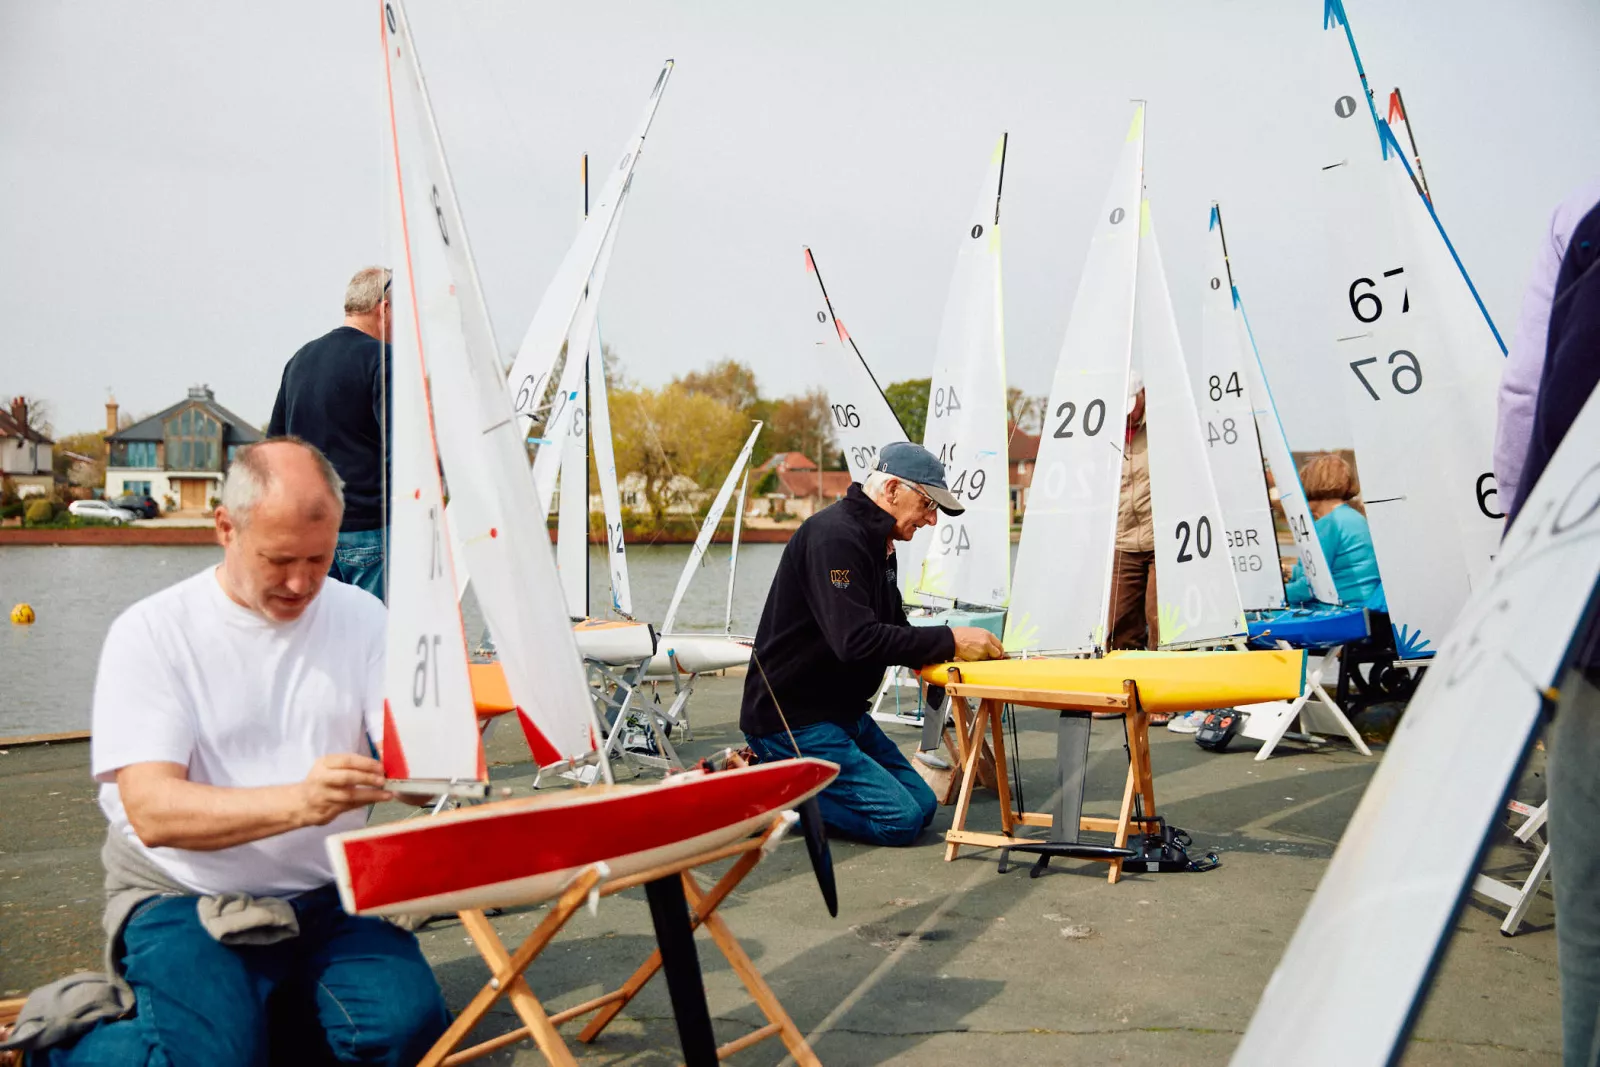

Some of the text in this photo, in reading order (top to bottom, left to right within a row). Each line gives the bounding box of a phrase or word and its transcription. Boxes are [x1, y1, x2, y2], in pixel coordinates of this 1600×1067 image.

[1208, 371, 1244, 401] 84
[831, 404, 861, 428] 106
[1053, 398, 1106, 439] 20
[950, 469, 986, 501] 49
[1175, 515, 1212, 563] 20
